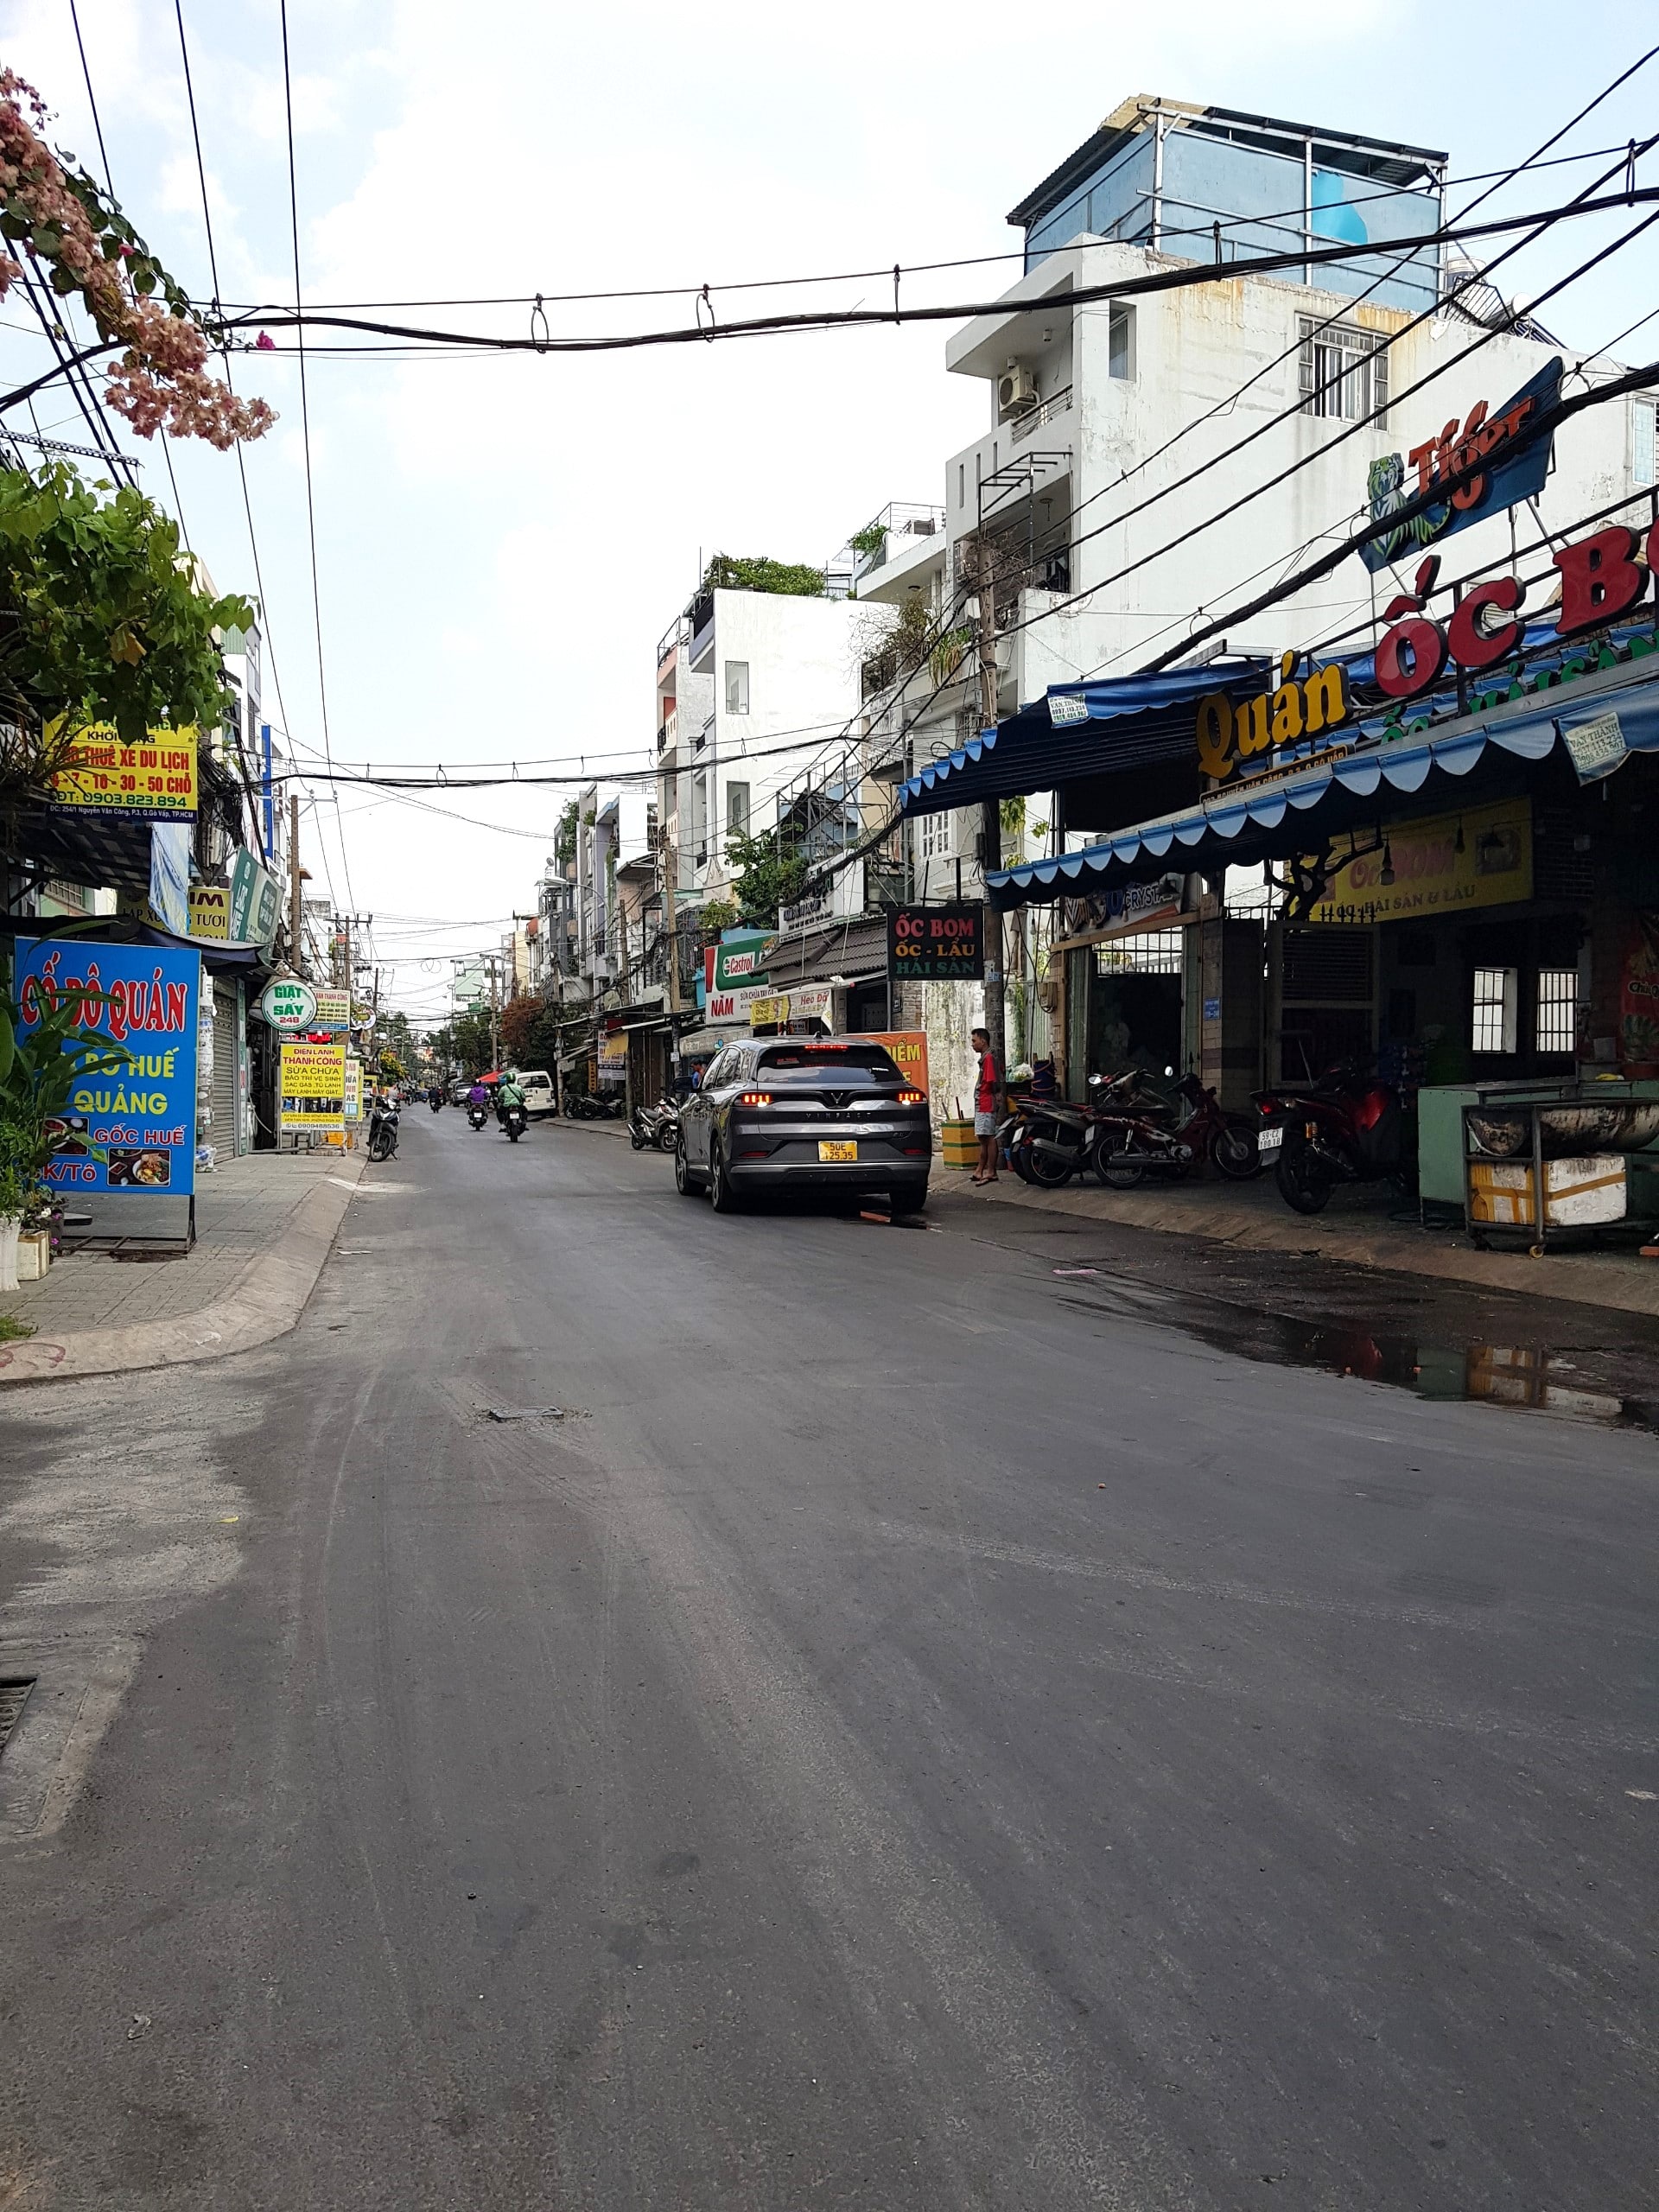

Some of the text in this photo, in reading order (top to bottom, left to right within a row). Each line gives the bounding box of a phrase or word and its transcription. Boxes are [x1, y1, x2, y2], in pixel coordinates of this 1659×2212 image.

[1196, 650, 1346, 779] Quán
[1375, 554, 1528, 698] ỐC
[87, 729, 118, 741] KHỞI
[119, 748, 137, 767] XE
[140, 749, 157, 768] DU
[161, 751, 189, 773] LỊCH
[72, 772, 80, 788] 7
[119, 774, 136, 791] 30
[148, 775, 163, 792] 50
[167, 772, 192, 794] CHỖ
[83, 792, 188, 807] 0903.823.894
[78, 805, 100, 816] Nguyễn
[171, 810, 194, 818] TP.HCM
[1364, 897, 1391, 914] HẢI
[1393, 892, 1423, 911] SẢN
[195, 912, 226, 928] TƯƠI
[895, 912, 975, 938] ỐC BOM
[895, 938, 922, 957] ỐC
[936, 936, 976, 957] LẨU
[729, 954, 753, 975] Castrol
[895, 957, 976, 975] HẢI SẢN
[108, 966, 188, 1041] QUÁN
[273, 1001, 304, 1016] SẤY
[710, 995, 734, 1018] NĂM
[800, 995, 815, 1006] Heo
[129, 1046, 181, 1078] HUẾ
[283, 1055, 342, 1066] THÀNH CÔNG
[286, 1065, 308, 1075] SỬA
[309, 1066, 340, 1076] CHỮA
[73, 1083, 168, 1116] QUẢNG
[805, 1111, 872, 1120] VINFAST
[94, 1123, 188, 1146] GỐC HUẾ
[830, 1142, 847, 1152] 50E
